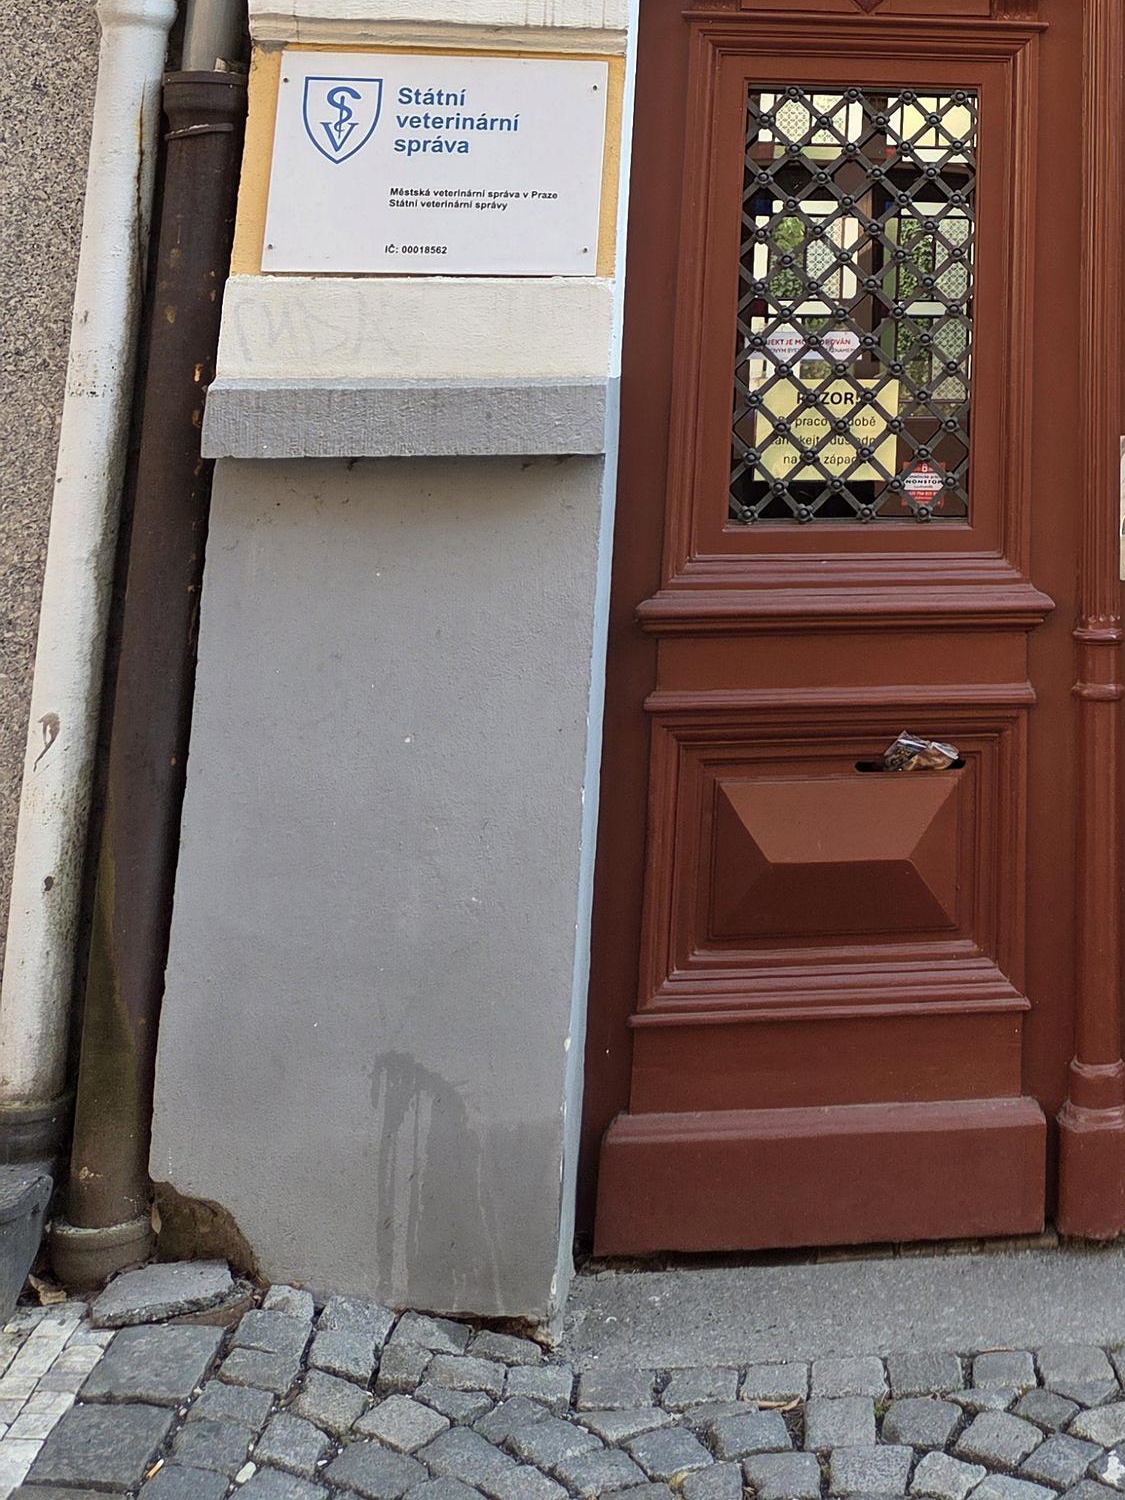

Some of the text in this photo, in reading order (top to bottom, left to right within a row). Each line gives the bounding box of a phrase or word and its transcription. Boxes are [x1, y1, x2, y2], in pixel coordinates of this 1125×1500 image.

[398, 87, 466, 106] Státní
[396, 112, 520, 131] veterinární
[393, 135, 469, 156] správa
[390, 187, 431, 197] Městská
[433, 189, 485, 198] veterinární
[487, 190, 520, 200] správa
[531, 191, 558, 199] Praze
[389, 199, 508, 211] Státní veterinární správy
[385, 244, 448, 254] IČ: 00018562
[795, 337, 850, 346] MOOROVÁN
[797, 392, 860, 405] PZOR!
[771, 435, 822, 449] amkejt
[784, 454, 866, 467] na zápa
